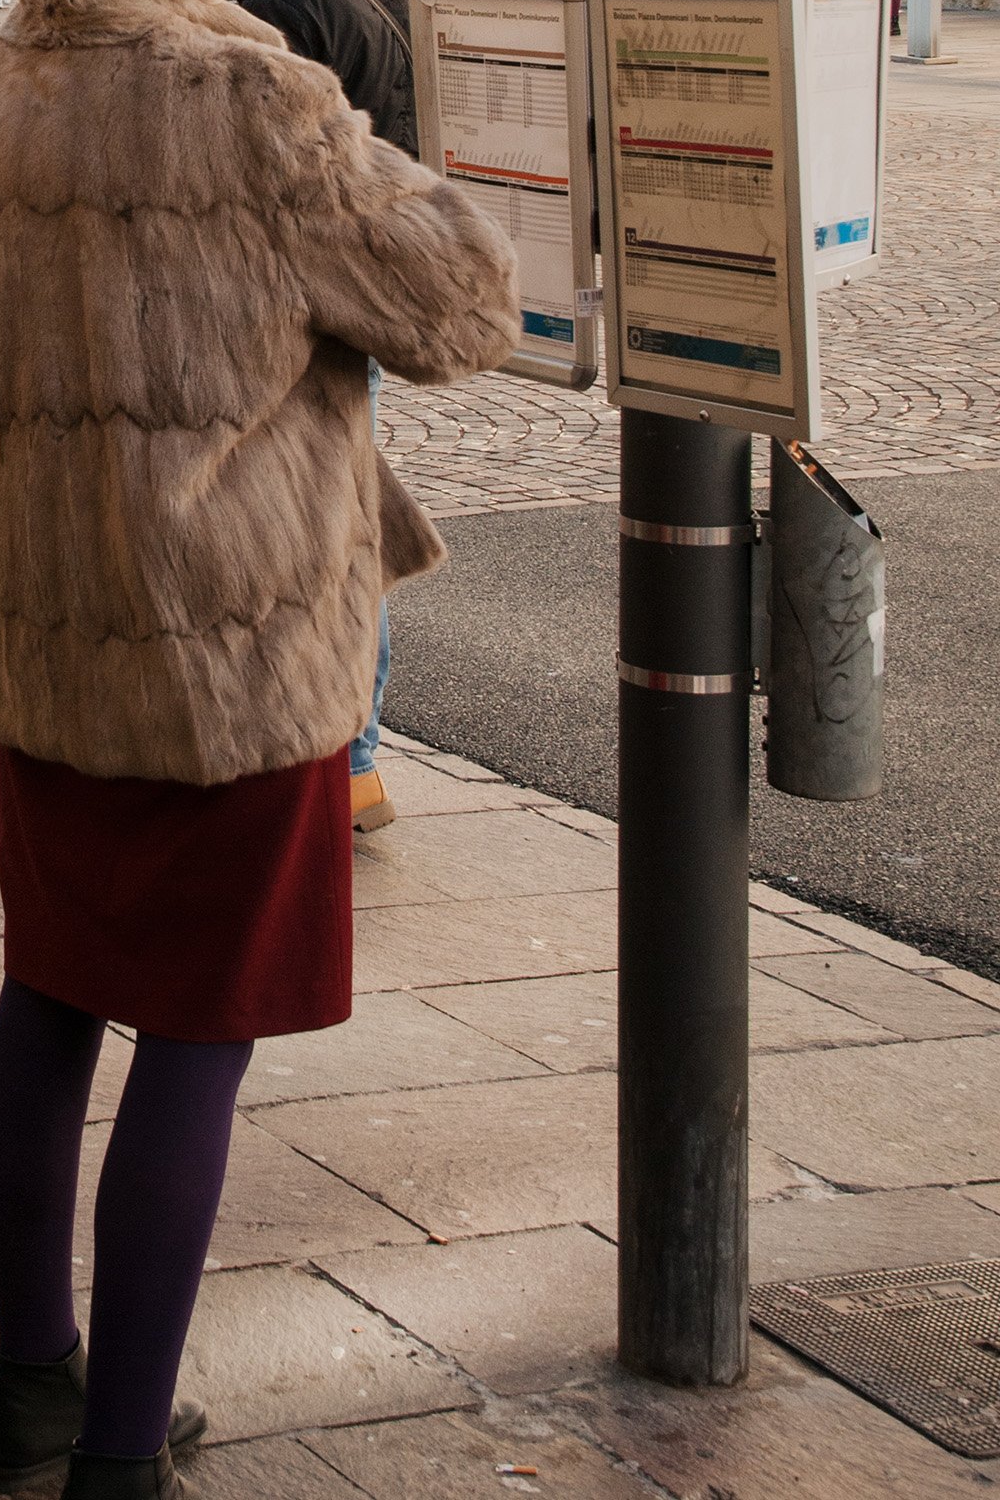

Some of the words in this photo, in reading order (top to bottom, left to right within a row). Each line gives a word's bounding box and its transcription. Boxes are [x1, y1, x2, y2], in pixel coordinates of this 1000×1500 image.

[454, 8, 469, 16] Piazza
[470, 9, 498, 18] Domenicani
[638, 12, 655, 21] Piazza
[656, 13, 689, 22] Domenicani
[626, 232, 636, 244] 12
